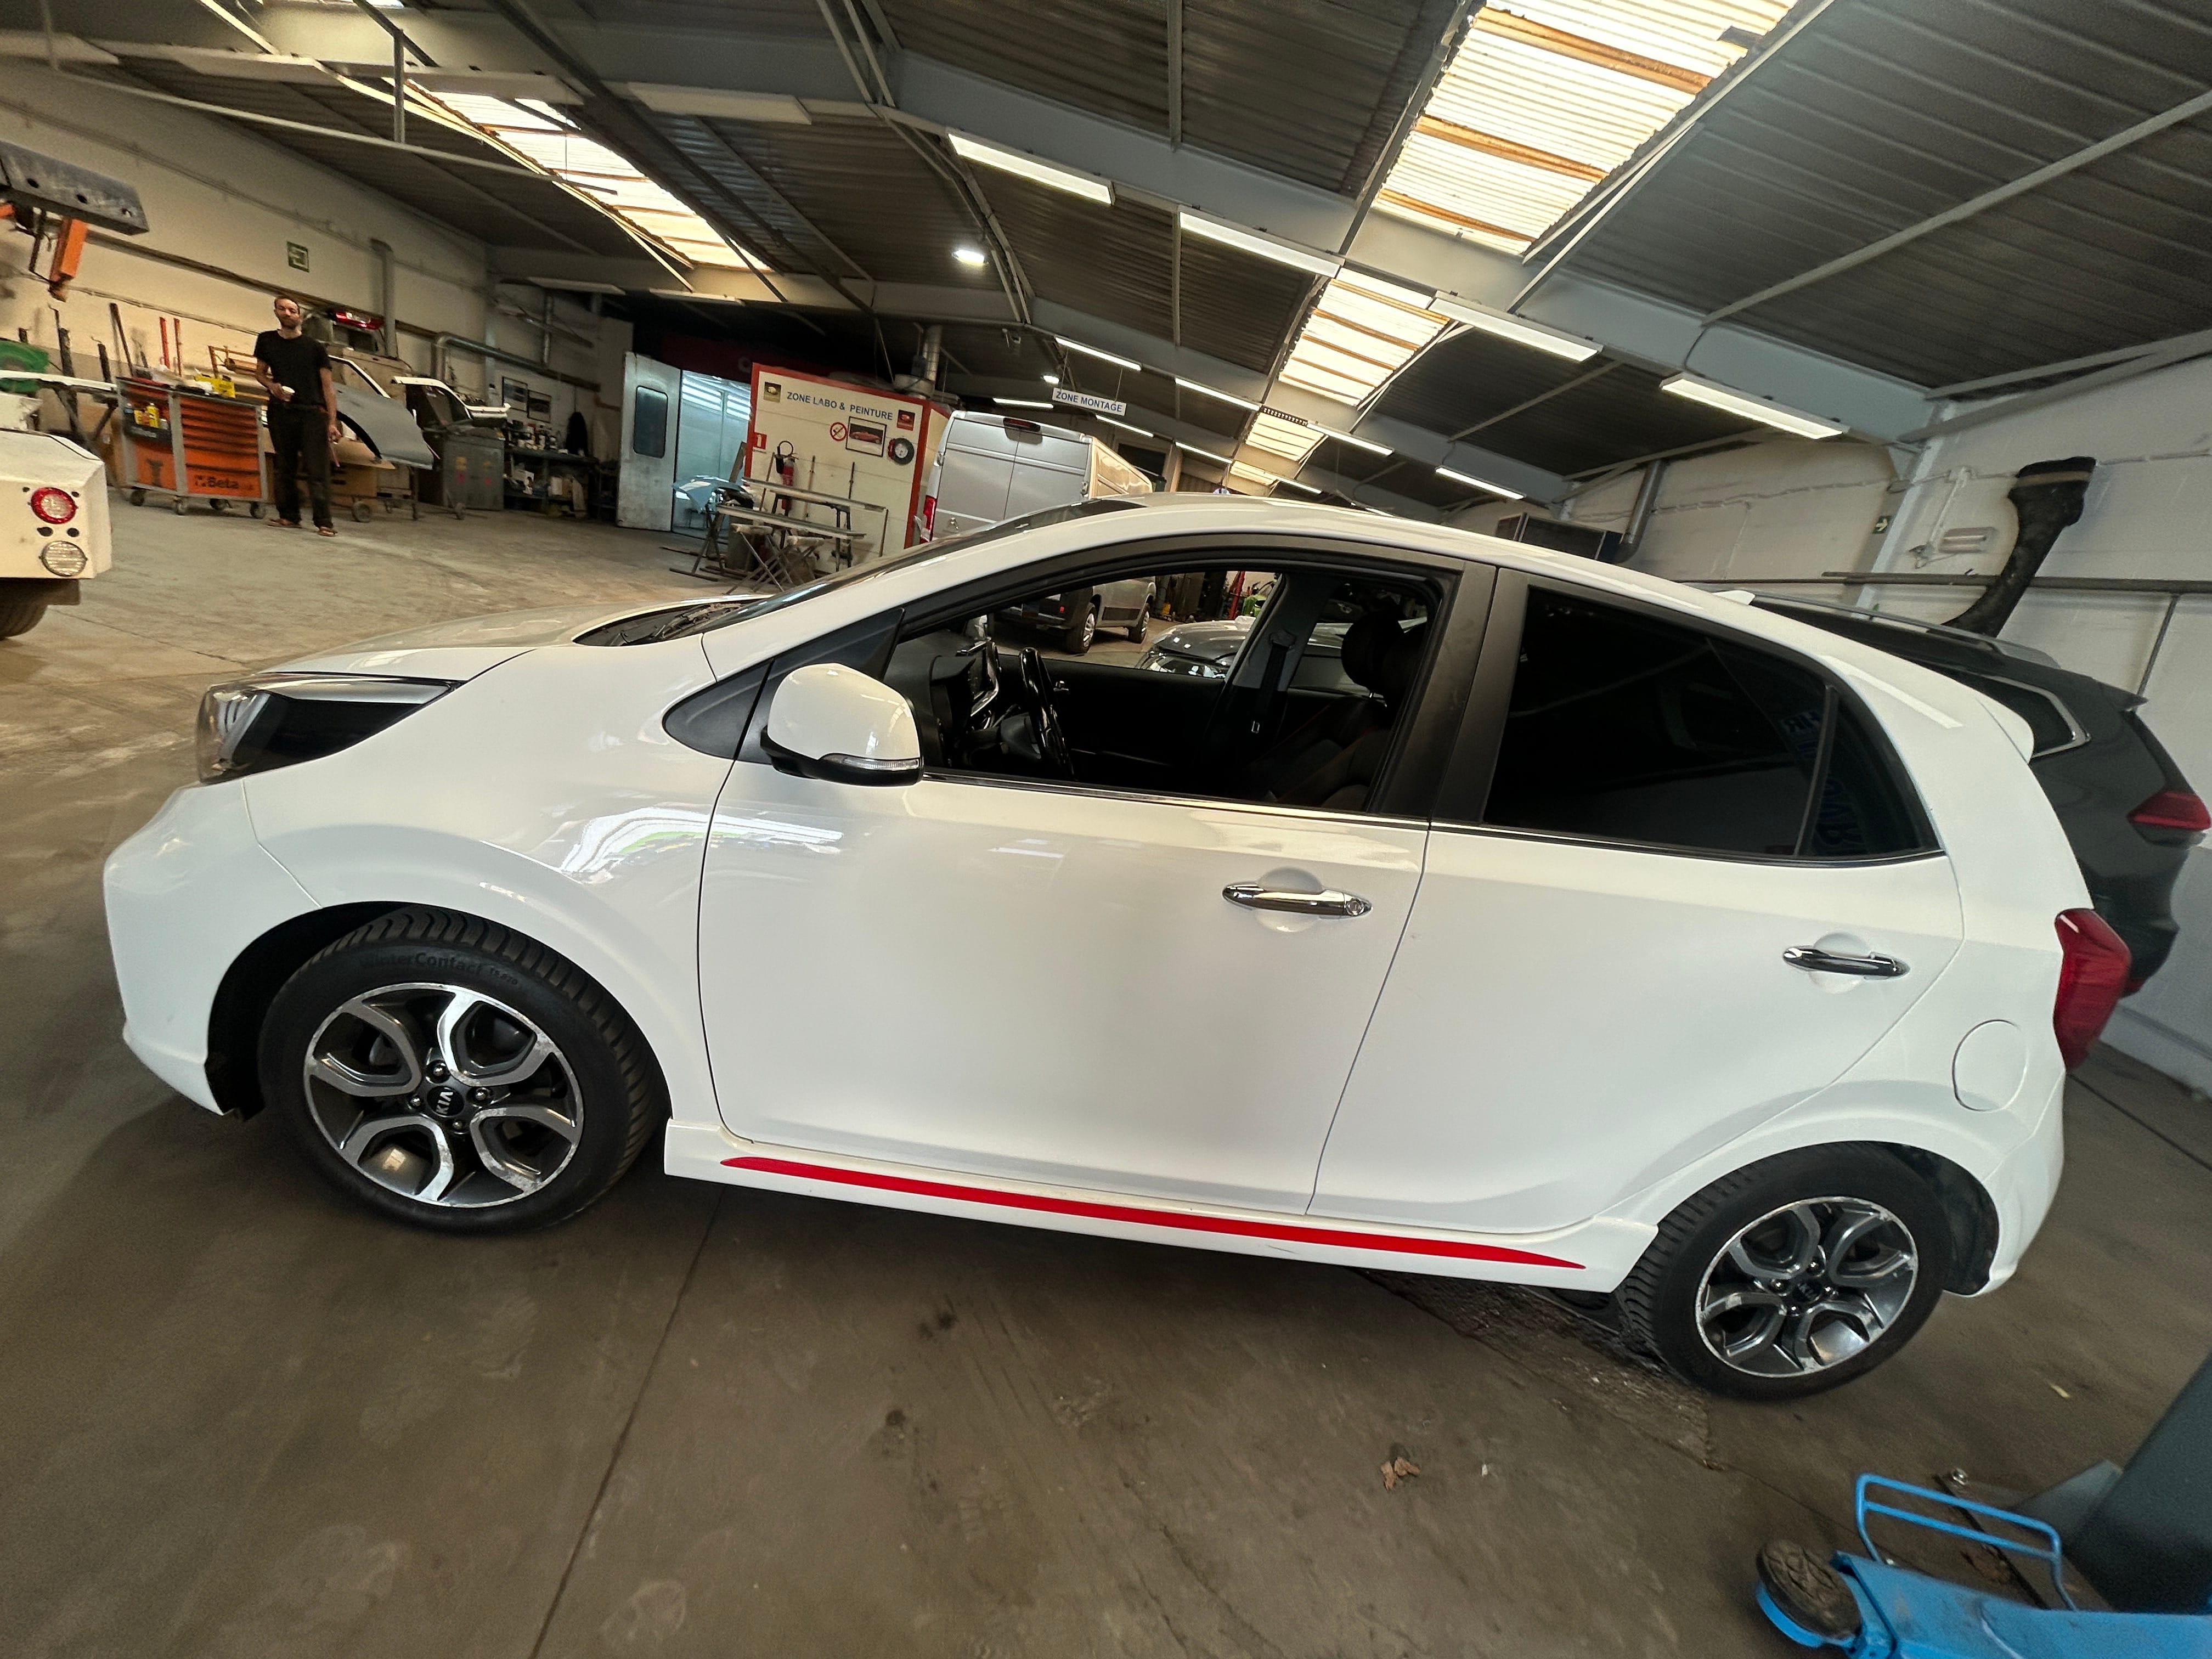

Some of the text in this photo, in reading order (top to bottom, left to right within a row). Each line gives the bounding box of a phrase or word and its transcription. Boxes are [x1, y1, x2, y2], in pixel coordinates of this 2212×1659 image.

[787, 392, 893, 420] ZONE LABO & PEINTURE
[1056, 391, 1122, 412] ZONE MONTAGE
[208, 476, 239, 489] Beta
[436, 1091, 454, 1114] KIA
